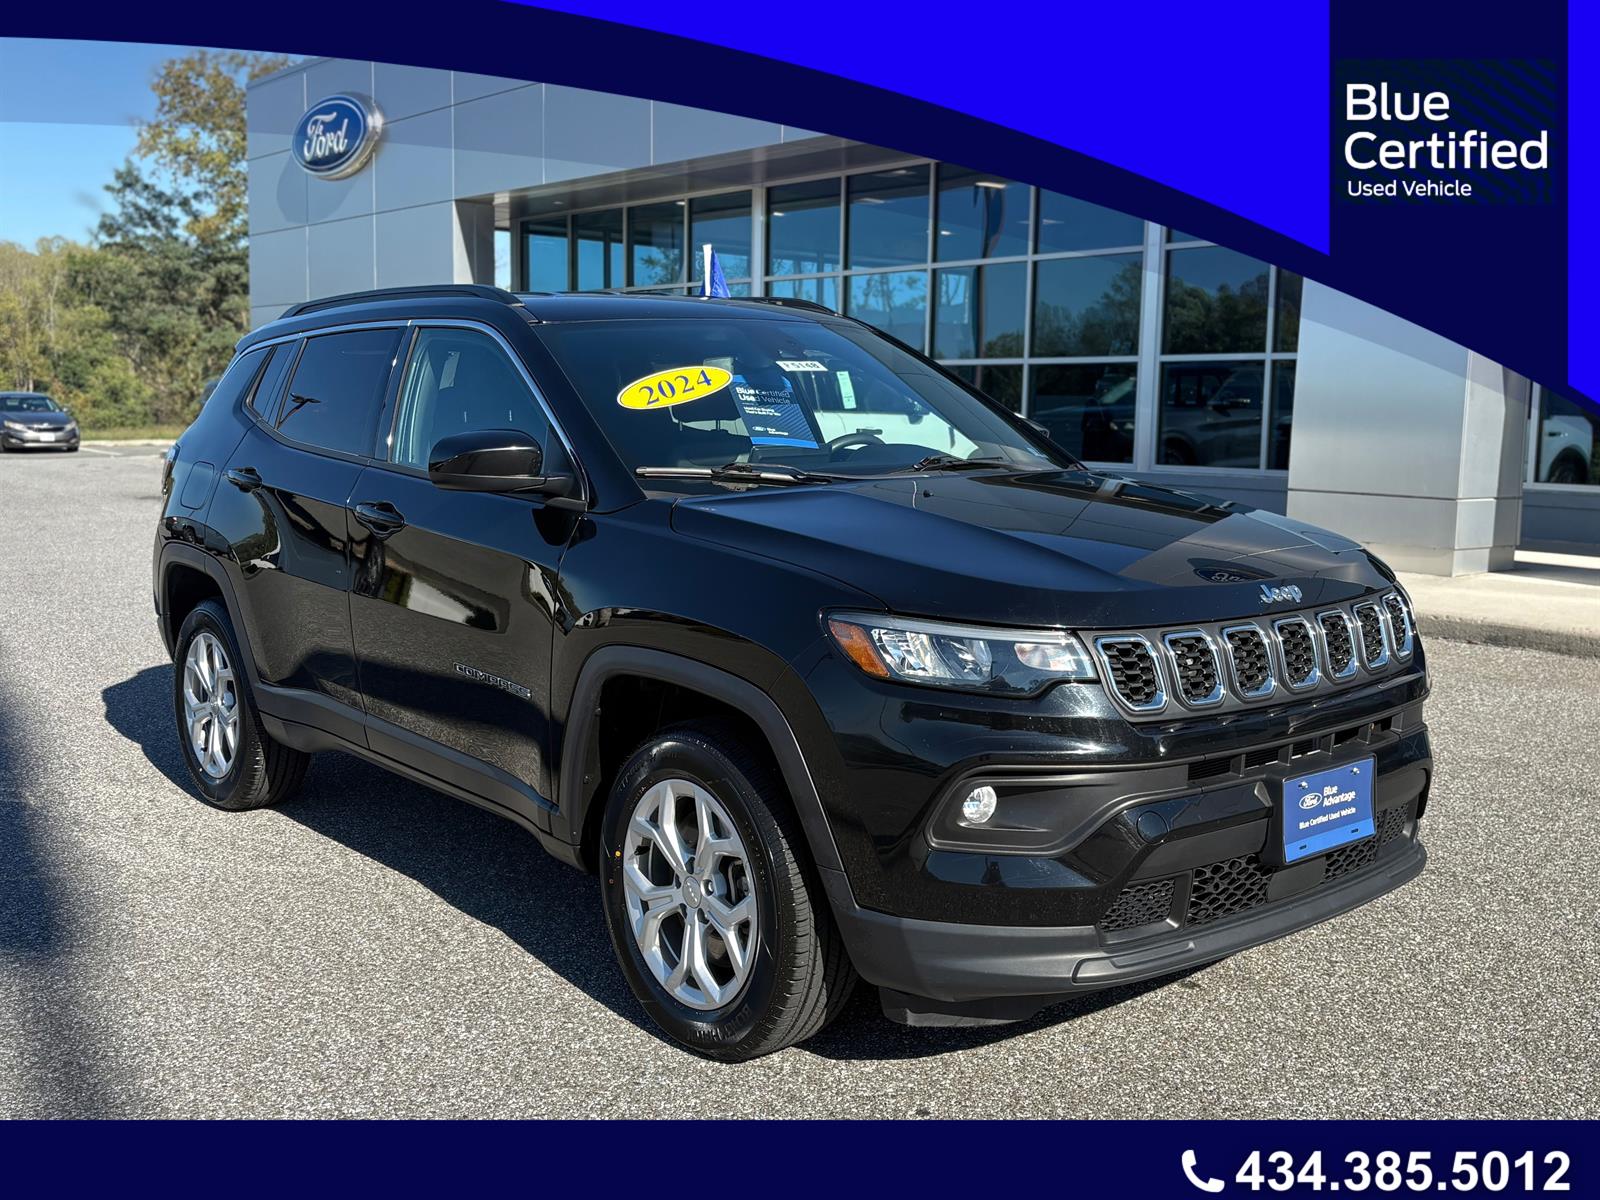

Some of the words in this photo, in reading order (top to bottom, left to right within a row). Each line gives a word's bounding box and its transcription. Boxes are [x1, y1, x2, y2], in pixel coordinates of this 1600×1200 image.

[303, 111, 349, 162] Ford
[638, 369, 712, 406] 2024
[735, 386, 756, 395] Blue
[738, 393, 760, 402] Used
[1260, 584, 1303, 604] Jeep
[1322, 790, 1356, 807] Advantage
[1323, 785, 1338, 796] Blue
